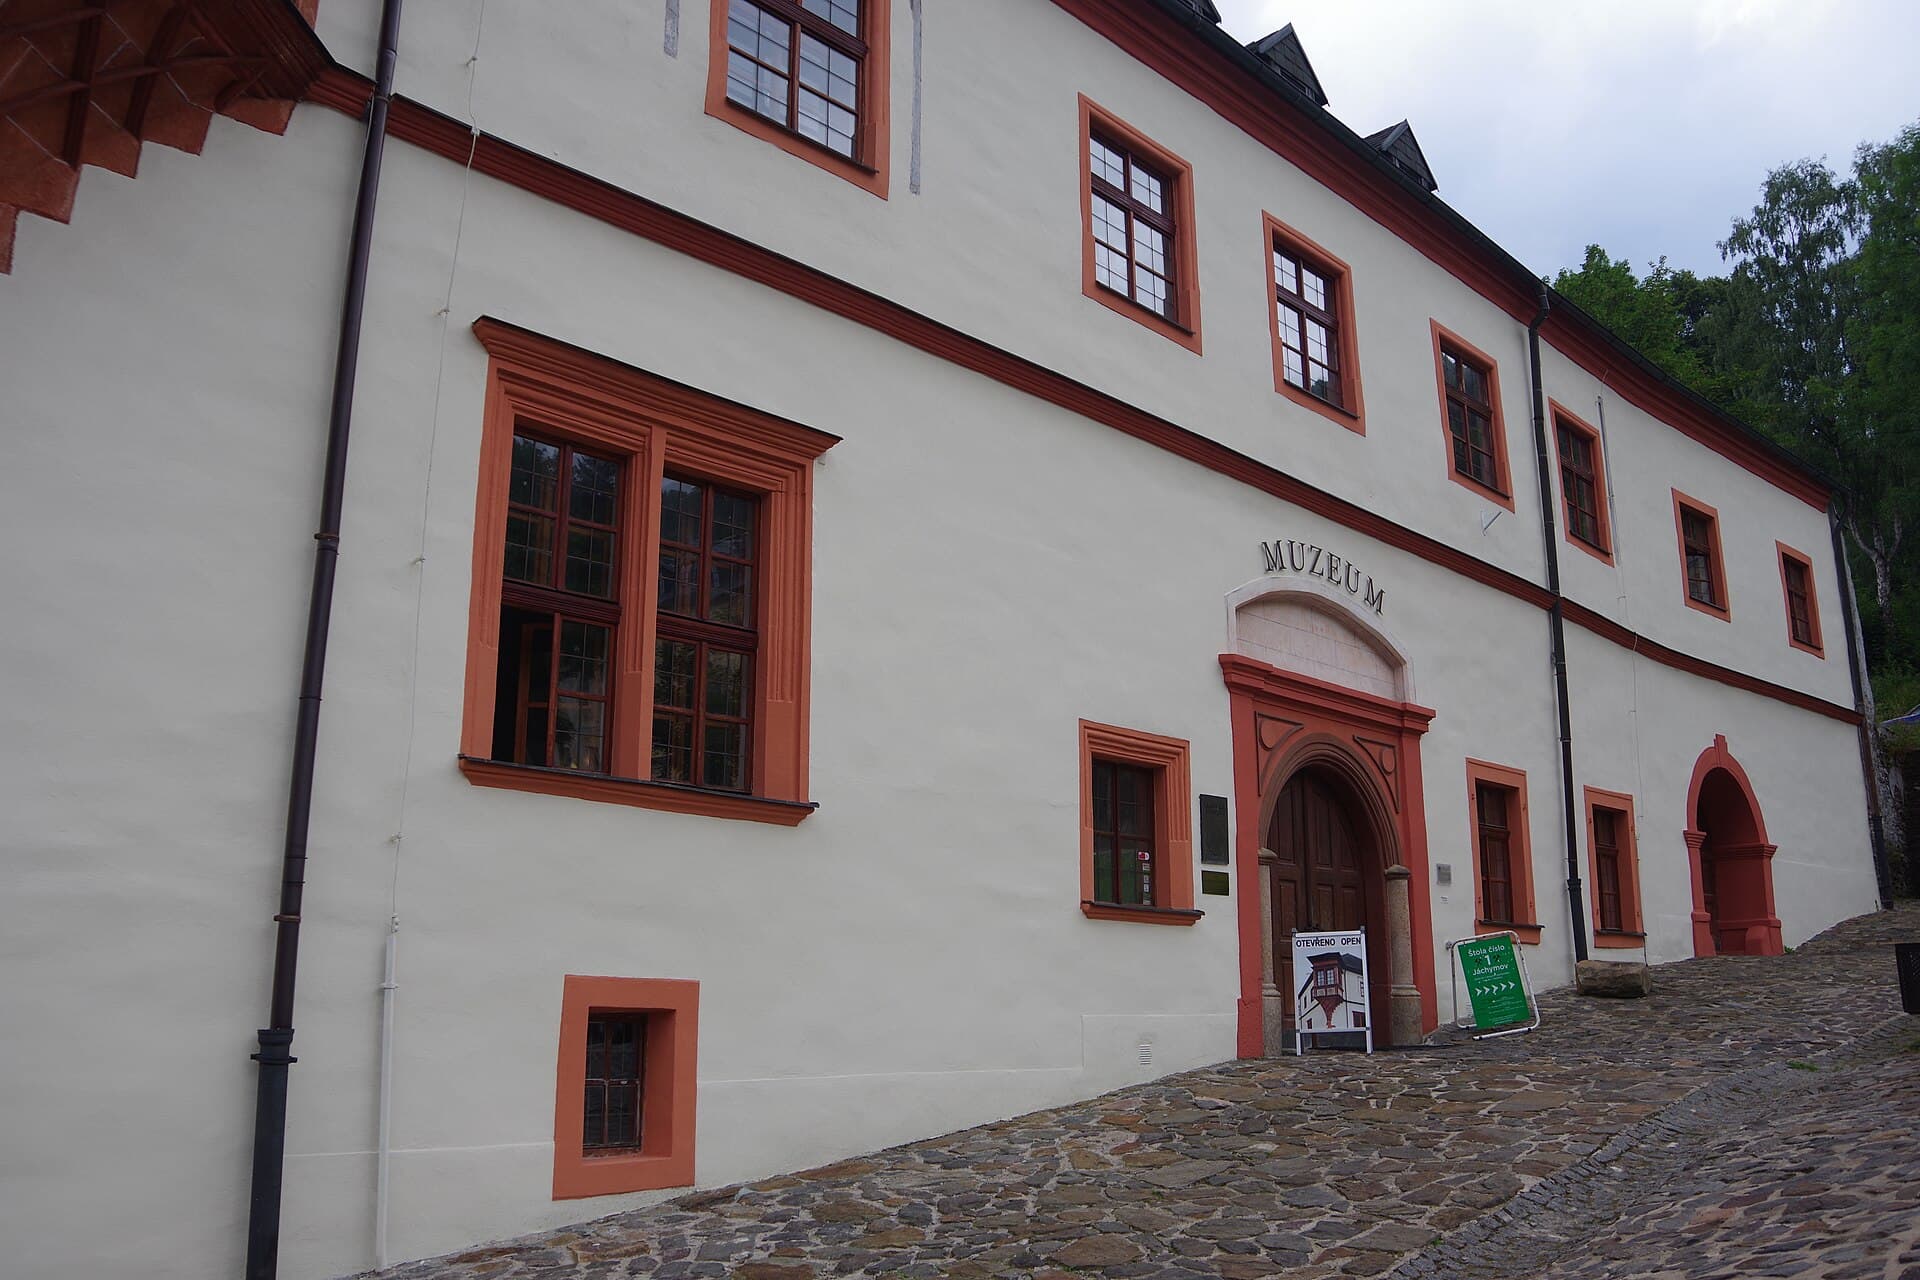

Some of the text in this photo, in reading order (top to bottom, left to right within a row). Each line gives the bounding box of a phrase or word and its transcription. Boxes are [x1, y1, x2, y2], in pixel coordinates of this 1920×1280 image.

[1261, 539, 1386, 615] MUZEUM
[1296, 937, 1361, 948] OTEVŘENO OPEN
[1468, 947, 1487, 957] Štola
[1484, 954, 1491, 966] 1
[1472, 963, 1509, 976] Jáchymov
